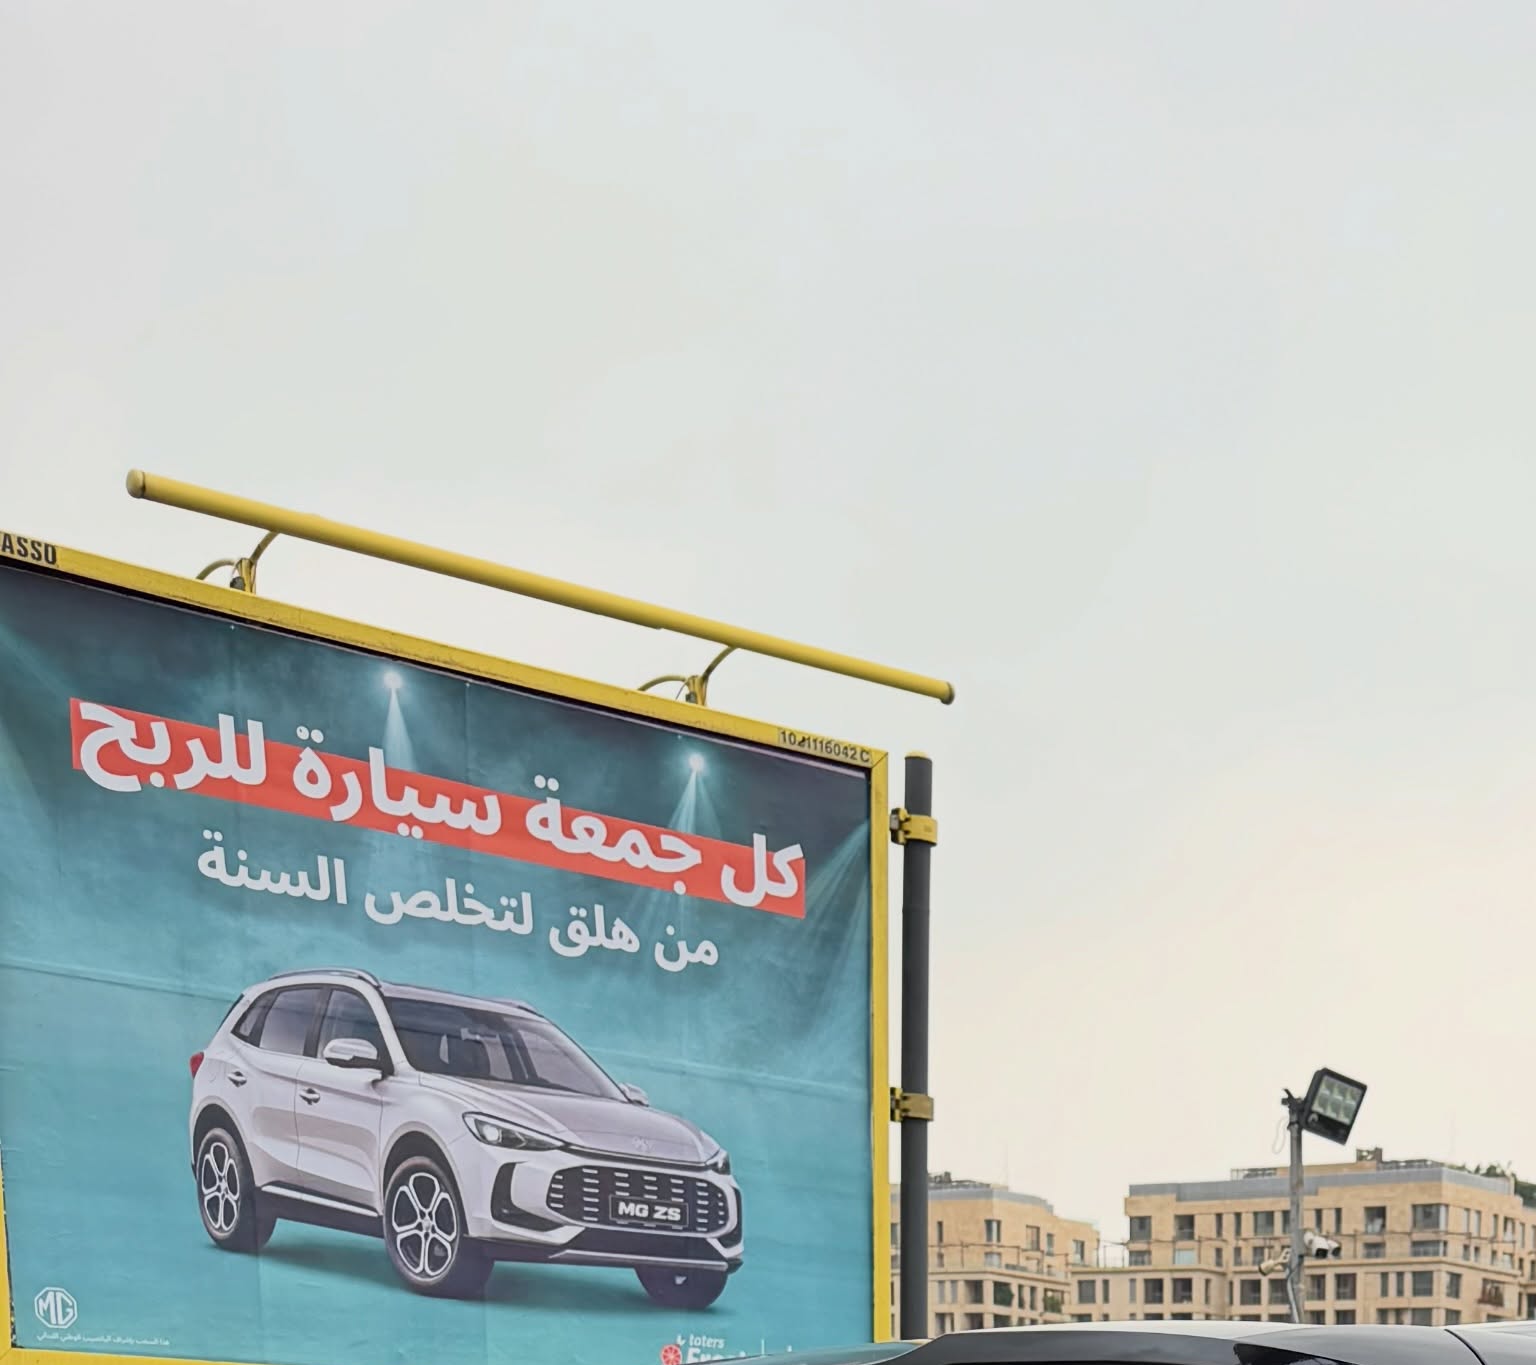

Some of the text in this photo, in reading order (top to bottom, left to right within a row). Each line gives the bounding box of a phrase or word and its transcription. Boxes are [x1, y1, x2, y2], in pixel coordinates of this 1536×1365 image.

[79, 701, 804, 907] كل جمعة سيارة للربح
[197, 829, 719, 972] من هلق لتخلص السنة
[618, 1201, 681, 1221] MG ZS
[38, 1291, 74, 1325] MG
[689, 1333, 725, 1349] toters
